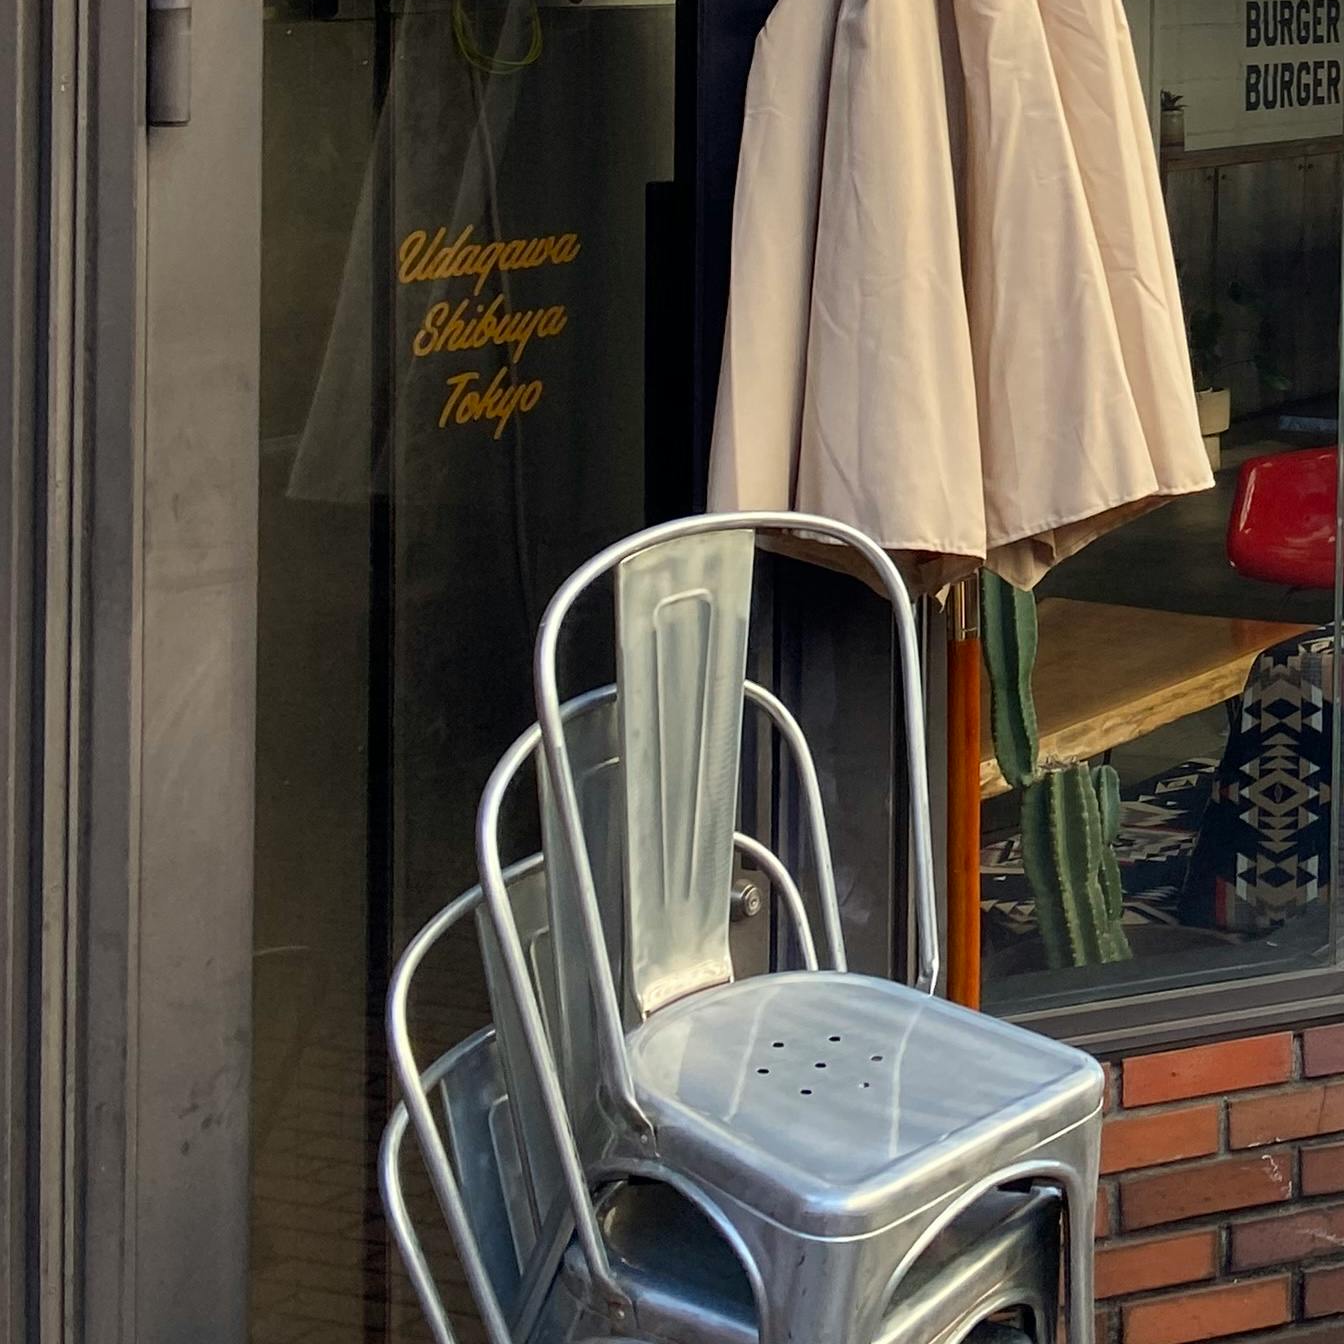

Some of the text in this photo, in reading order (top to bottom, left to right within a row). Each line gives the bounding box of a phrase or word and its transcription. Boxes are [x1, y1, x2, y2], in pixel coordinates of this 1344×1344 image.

[1246, 0, 1340, 47] BURGER
[1246, 61, 1340, 111] BURGER
[399, 224, 581, 296] Udagawa
[413, 293, 568, 364] Shibuya
[438, 366, 543, 440] Tokyo
